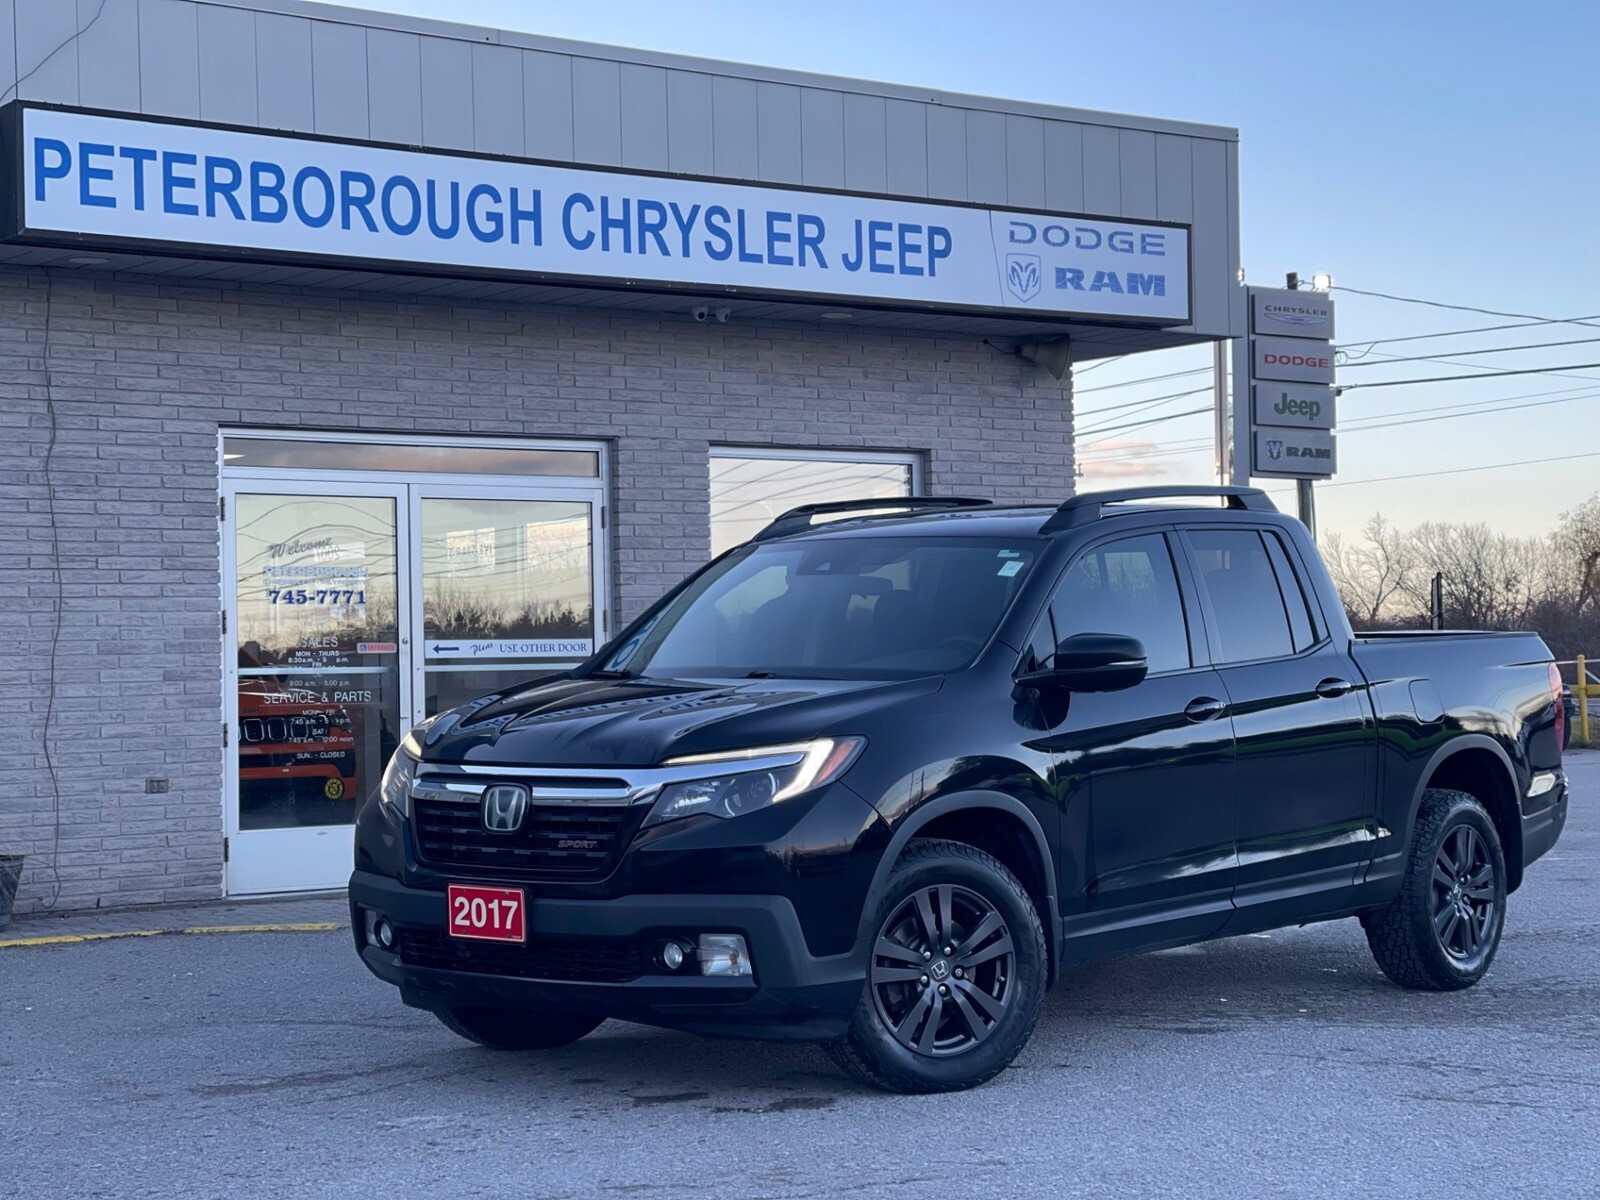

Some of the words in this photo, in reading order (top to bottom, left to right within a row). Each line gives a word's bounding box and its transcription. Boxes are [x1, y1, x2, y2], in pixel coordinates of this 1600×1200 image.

[33, 136, 543, 247] PETERBOROUGH
[561, 192, 829, 270] CHRYSLER
[841, 219, 952, 278] JEEP
[1009, 221, 1166, 257] DODGE
[1055, 266, 1166, 297] RAM
[1264, 304, 1328, 316] CHRYSLER
[1263, 353, 1330, 368] DODGE
[1274, 392, 1321, 421] Jeep
[1285, 446, 1331, 460] RAM
[265, 537, 334, 559] Welcome
[268, 589, 366, 605] 745-7771
[300, 636, 339, 648] SALES
[499, 644, 518, 653] USE
[520, 643, 556, 653] OTHER
[558, 643, 587, 652] DOOR
[263, 692, 315, 704] SERVICE
[321, 692, 329, 703] &
[334, 690, 372, 702] PARTS
[320, 751, 346, 759] CLOSED
[557, 839, 598, 849] SPORT
[454, 896, 519, 930] 2017
